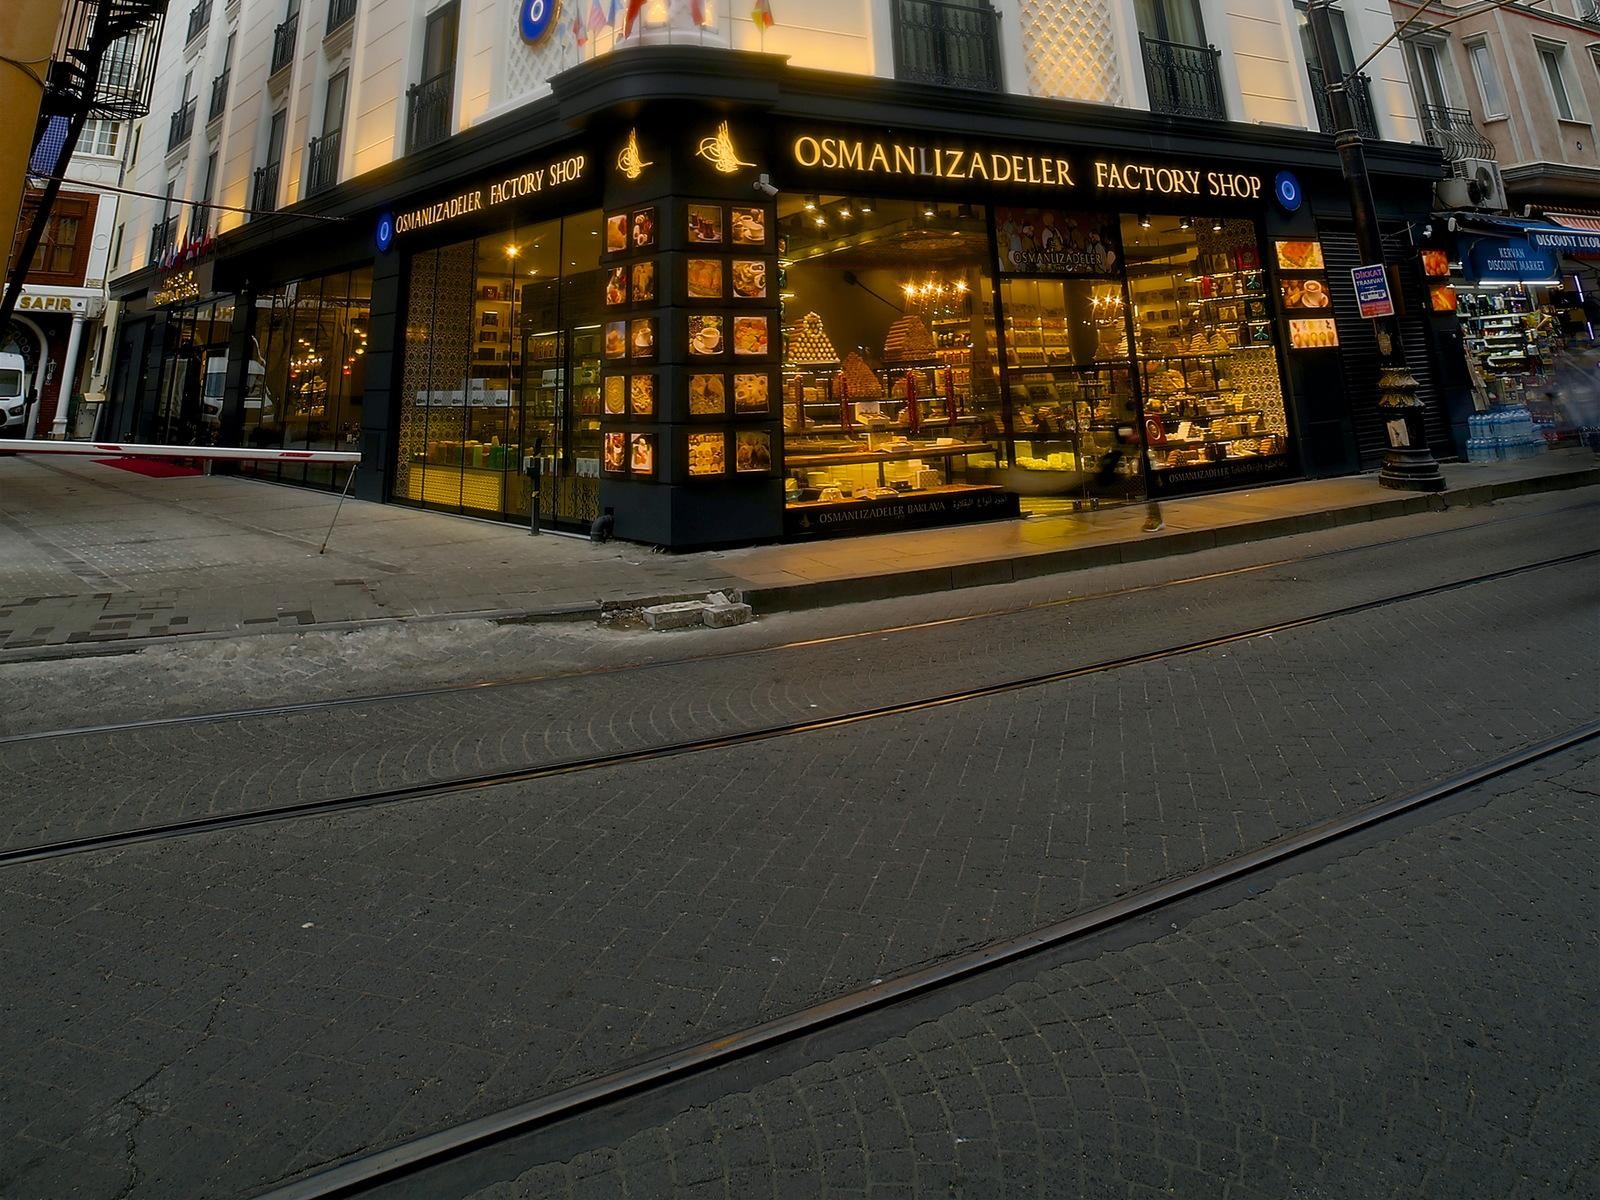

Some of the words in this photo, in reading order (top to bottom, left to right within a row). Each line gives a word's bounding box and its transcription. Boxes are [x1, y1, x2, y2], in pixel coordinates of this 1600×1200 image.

[793, 136, 1076, 186] OSMANLIZADELER
[1094, 162, 1201, 195] FACTORY
[1207, 171, 1262, 199] SHOP
[395, 190, 482, 234] OSMANLIZADELER
[489, 169, 545, 205] FACTORY
[549, 155, 586, 187] SHOP
[1535, 234, 1577, 247] DISCOUNT
[1013, 250, 1103, 265] OSMANLIZADELER
[1498, 247, 1526, 259] KERVAN
[1487, 259, 1518, 271] DISCOUNT
[1519, 260, 1545, 271] MARKET
[1356, 277, 1384, 287] TRAMVAY
[819, 504, 905, 524] OSMANLIZADELER
[907, 501, 946, 514] BAKLAVA
